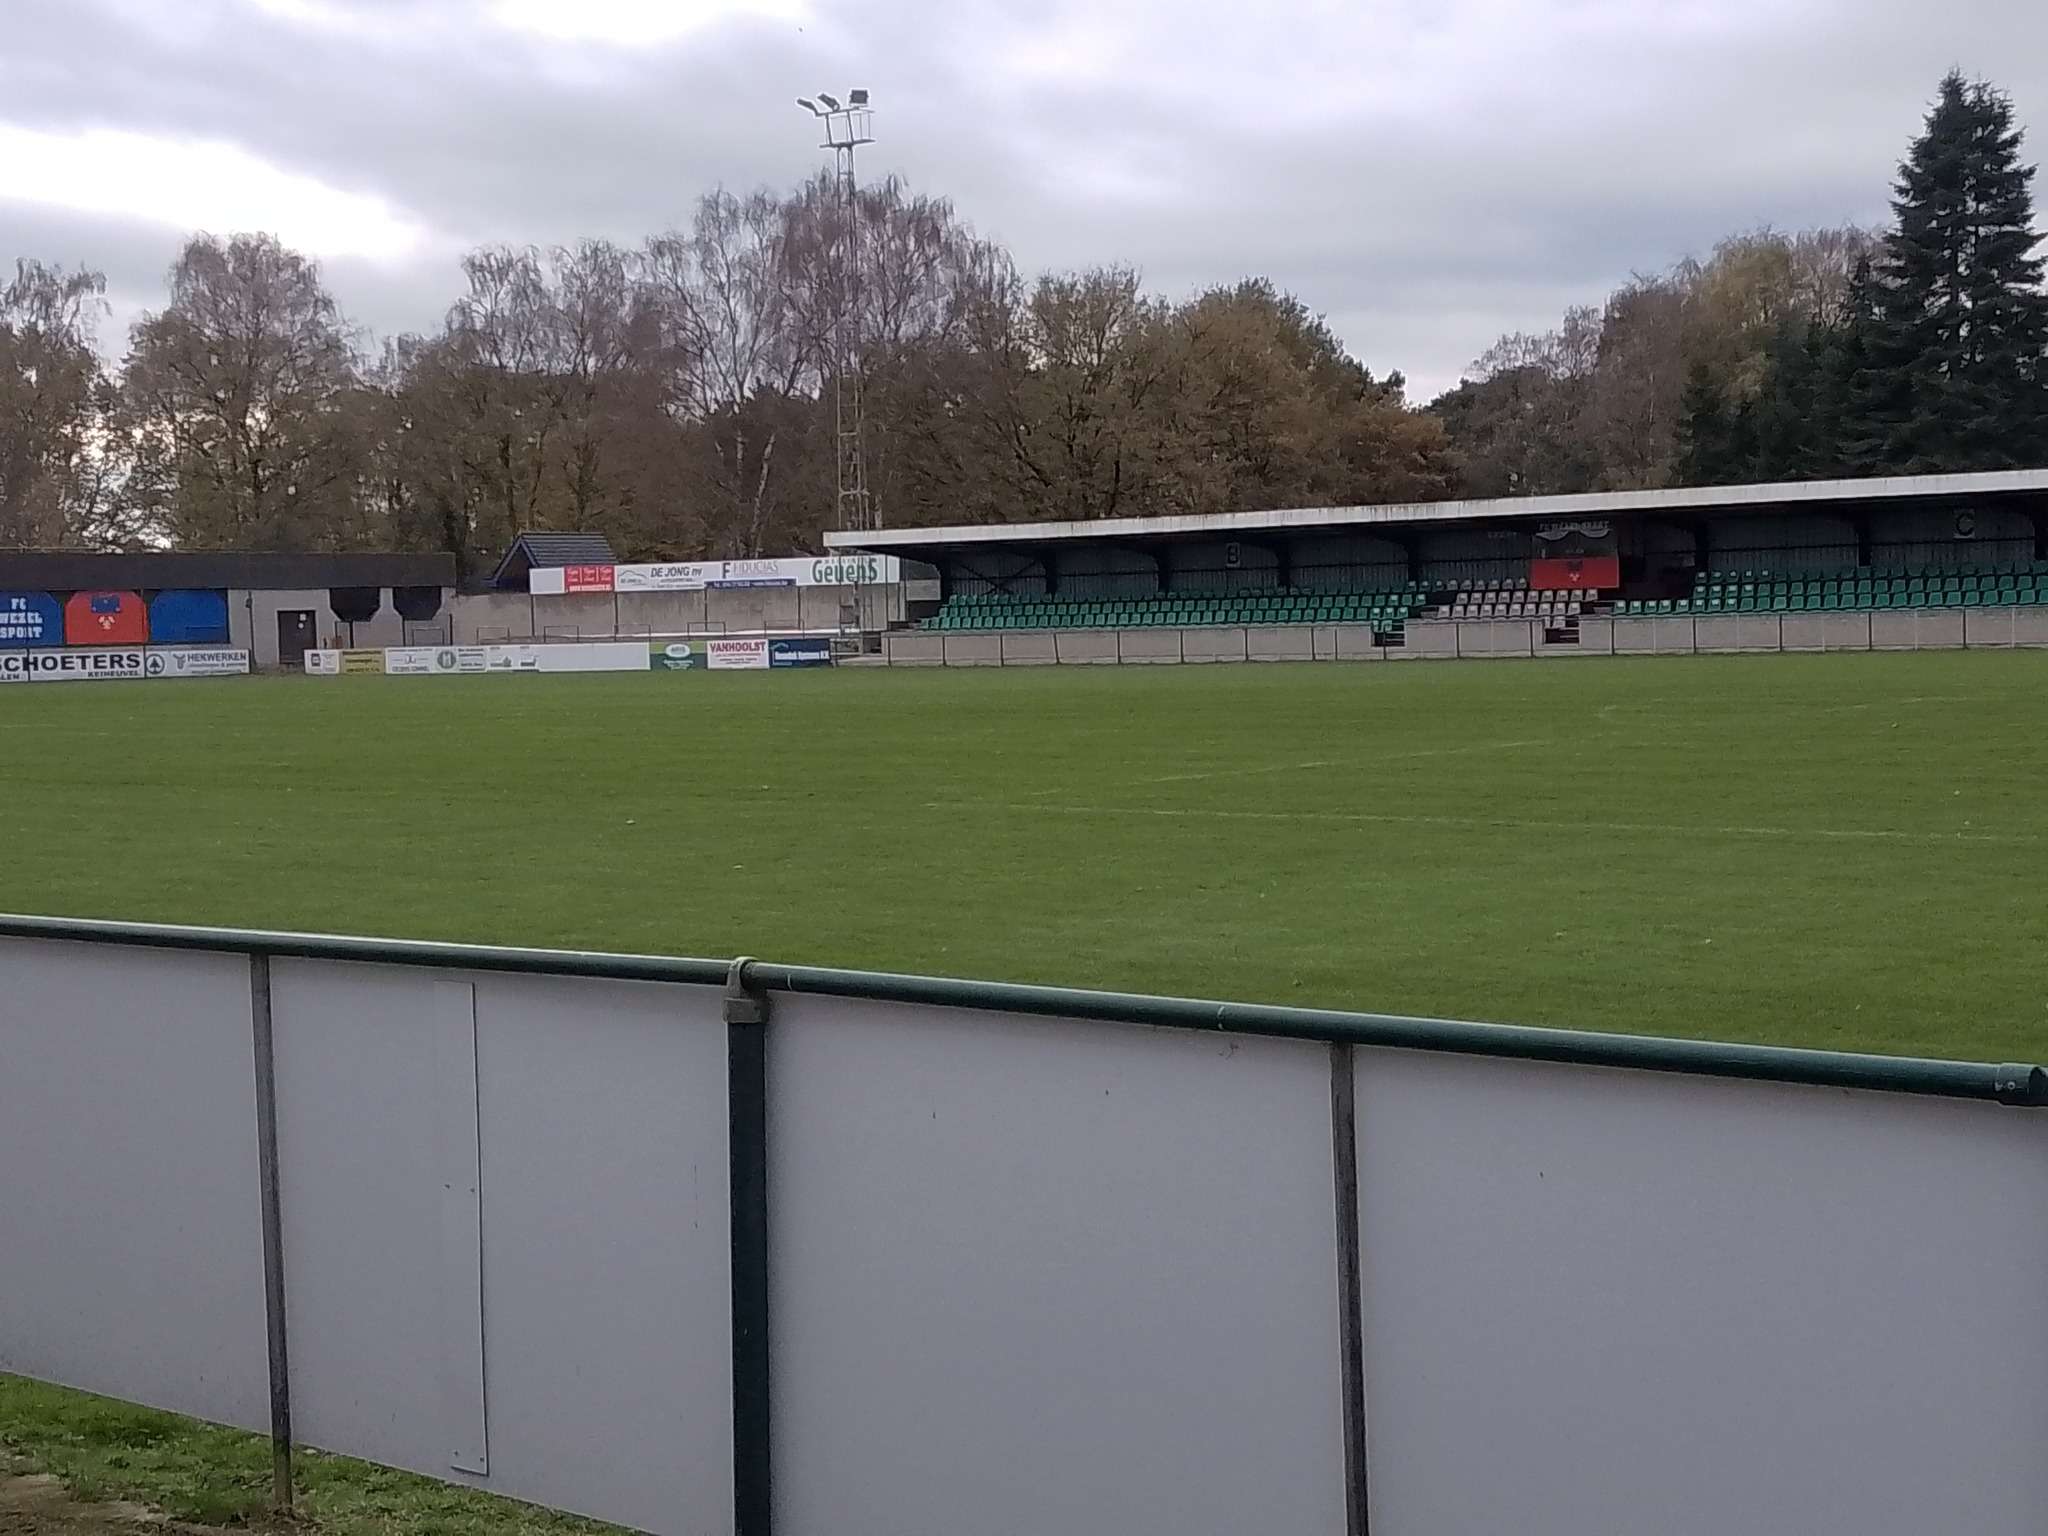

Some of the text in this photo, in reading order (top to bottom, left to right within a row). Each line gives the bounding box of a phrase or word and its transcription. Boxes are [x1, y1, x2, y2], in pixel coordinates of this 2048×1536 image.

[651, 567, 663, 578] DE
[664, 566, 690, 577] JONG
[11, 598, 26, 610] FC
[0, 626, 43, 639] SPORT
[709, 641, 766, 654] VANHOOLST
[0, 653, 141, 672] CHOETERS
[187, 651, 247, 663] HEKWERKEN
